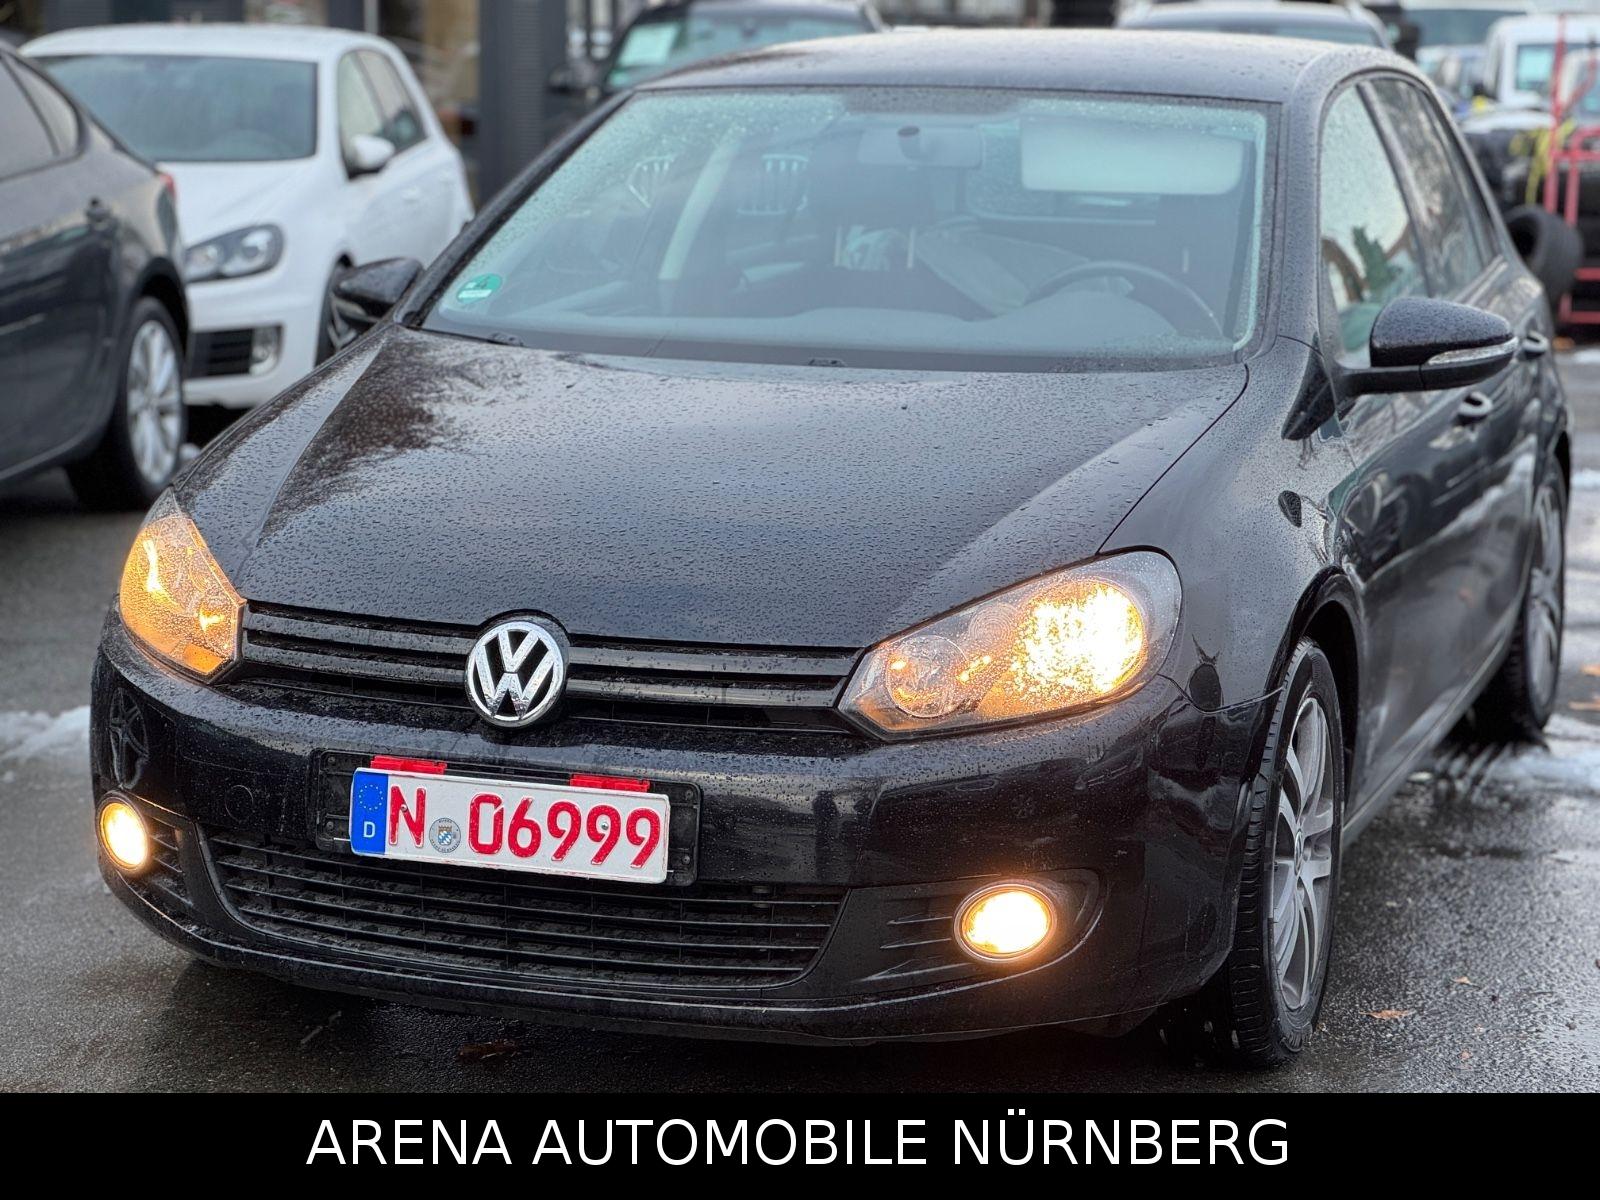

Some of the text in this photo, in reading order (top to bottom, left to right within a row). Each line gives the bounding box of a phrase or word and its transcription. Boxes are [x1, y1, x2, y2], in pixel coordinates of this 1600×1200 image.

[472, 626, 557, 721] VW
[363, 821, 376, 838] D
[389, 785, 427, 848] N
[468, 791, 662, 869] 06999
